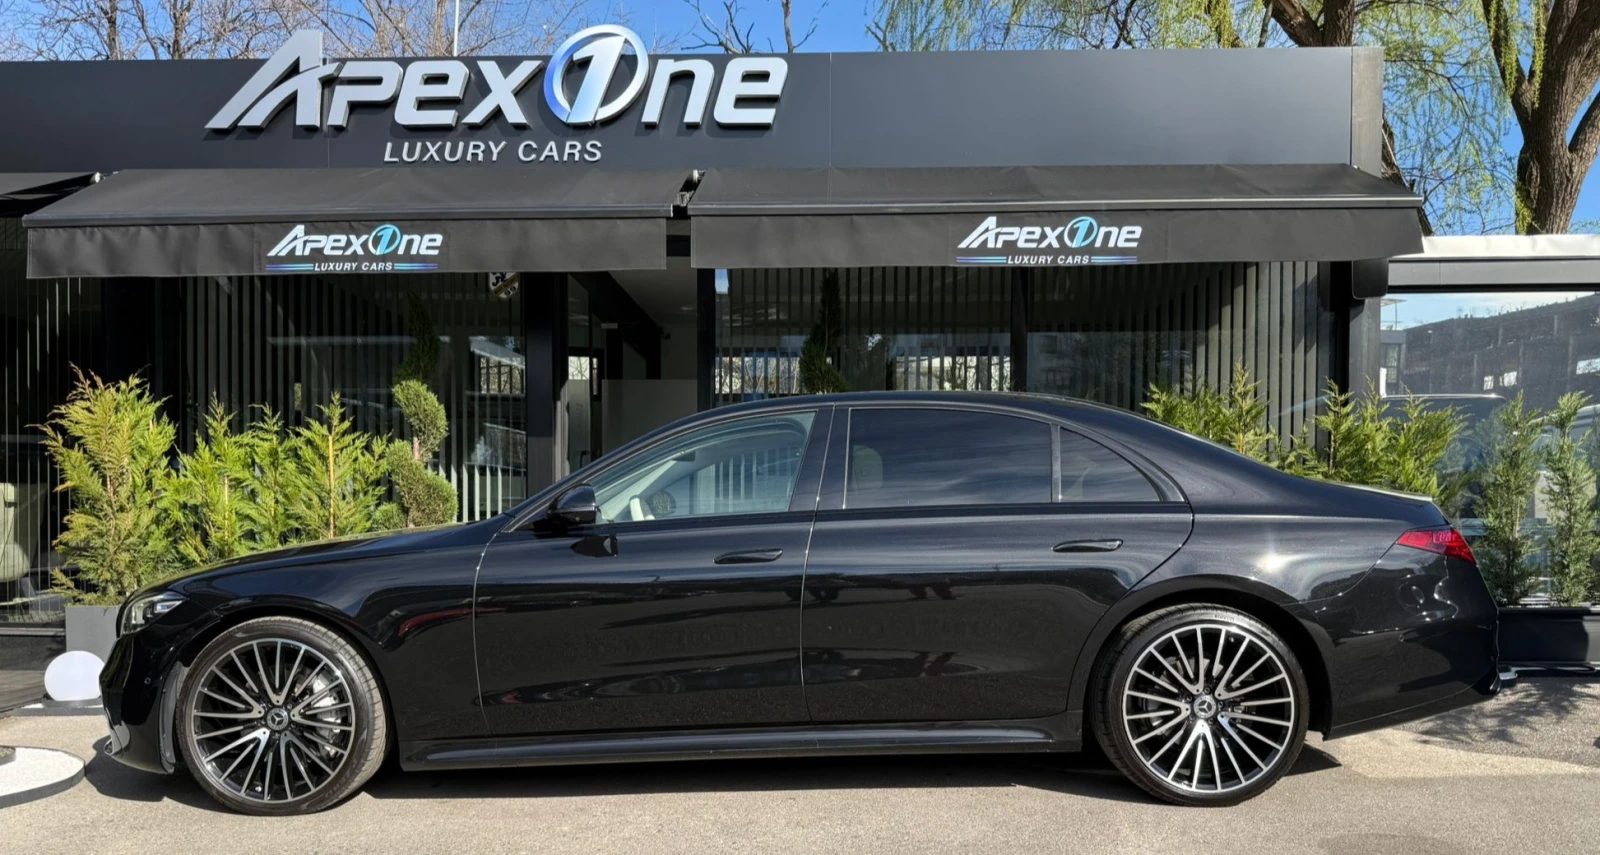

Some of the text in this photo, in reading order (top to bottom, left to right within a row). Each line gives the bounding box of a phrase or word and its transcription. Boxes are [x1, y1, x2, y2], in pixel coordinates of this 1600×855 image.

[383, 140, 603, 163] LUXURY CARS
[1007, 254, 1090, 265] LUXURY CARS
[314, 261, 393, 272] LUXURY CARS
